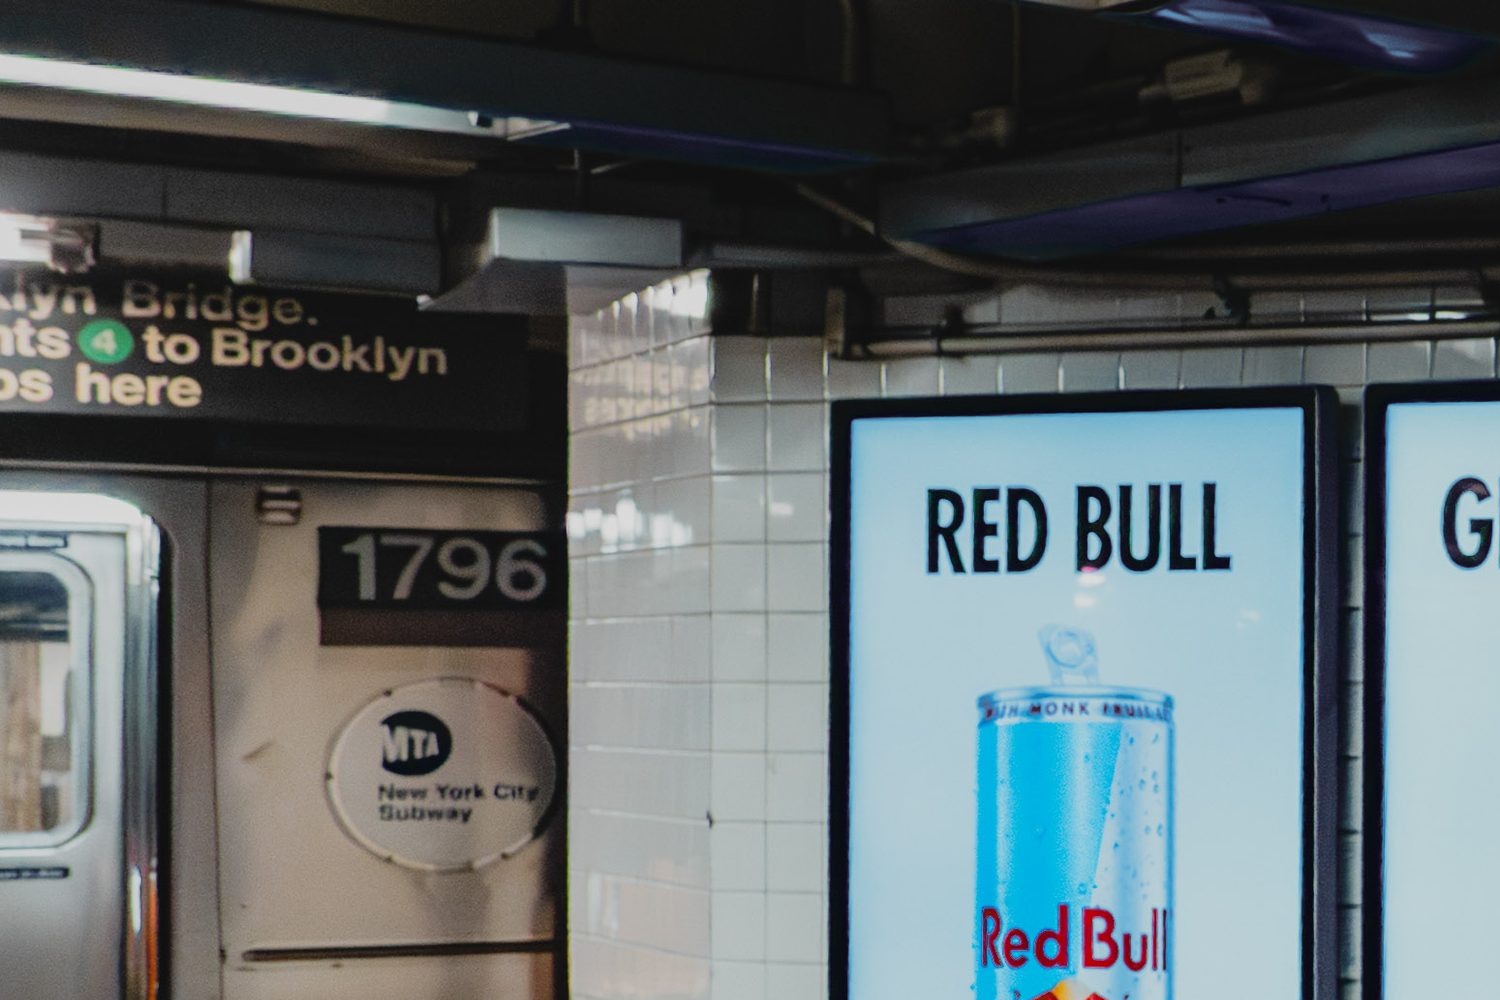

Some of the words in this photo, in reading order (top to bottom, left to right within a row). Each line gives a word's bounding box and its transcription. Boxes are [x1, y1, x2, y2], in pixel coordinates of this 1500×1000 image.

[122, 279, 319, 331] Bridge.
[92, 329, 118, 356] 4
[142, 325, 200, 364] to
[212, 328, 447, 380] Brooklyn
[76, 362, 202, 408] here
[926, 486, 1048, 573] RED
[1075, 482, 1232, 573] BULL
[341, 534, 548, 600] 1796
[1029, 702, 1090, 716] MONK
[378, 784, 428, 801] New
[436, 783, 484, 801] York
[494, 783, 540, 802] City
[378, 804, 473, 823] Subway
[981, 904, 1069, 968] Red
[1082, 907, 1167, 971] Bull
